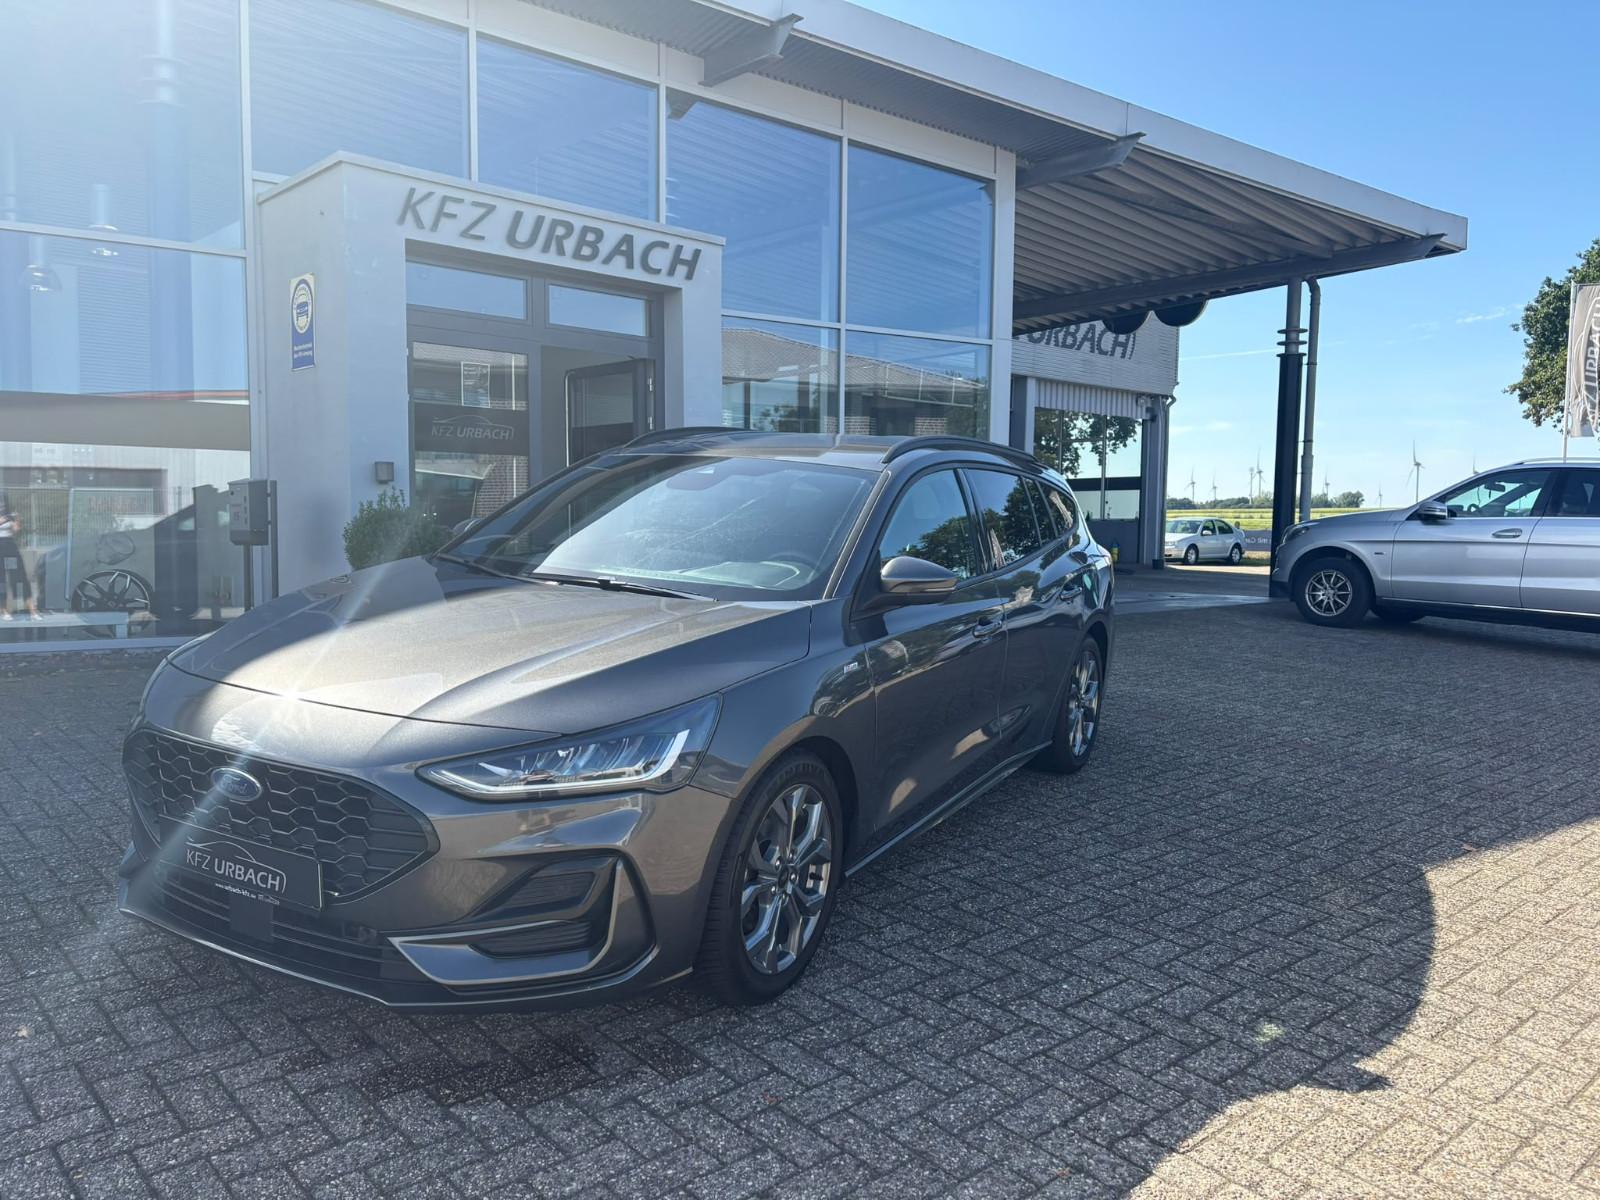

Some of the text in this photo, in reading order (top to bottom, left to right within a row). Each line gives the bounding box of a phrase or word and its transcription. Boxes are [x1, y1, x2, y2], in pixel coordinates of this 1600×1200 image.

[397, 187, 702, 280] KFZ URBACH
[432, 425, 510, 440] KFZ URBACH
[186, 849, 281, 891] KFZ URBACH
